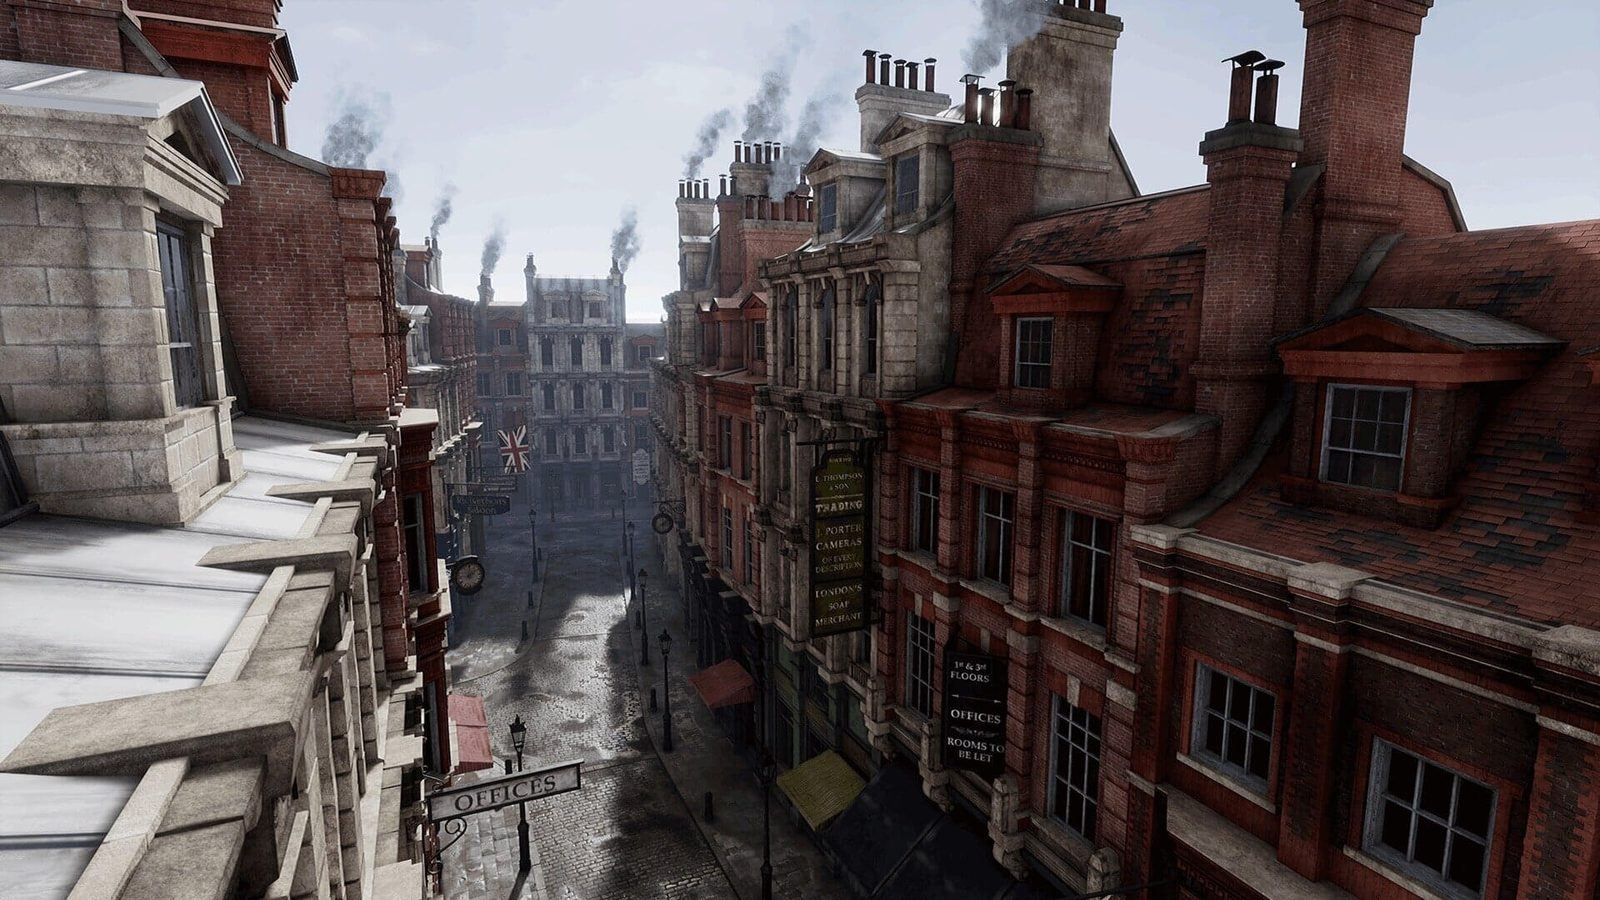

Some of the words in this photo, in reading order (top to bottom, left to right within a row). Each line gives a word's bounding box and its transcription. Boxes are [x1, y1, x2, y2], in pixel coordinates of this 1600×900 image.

[815, 500, 863, 513] TRADING
[825, 523, 862, 536] PORTER
[815, 537, 862, 551] CAMERAS
[815, 583, 863, 598] LONDON'S
[829, 600, 850, 611] SOAP
[815, 612, 862, 628] MERCHANT
[965, 662, 974, 671] &
[950, 670, 990, 683] FLOORS
[950, 709, 1001, 725] OFFICES
[947, 737, 988, 751] ROOMS
[989, 743, 1005, 753] TO
[959, 750, 972, 759] BE
[974, 752, 993, 763] LET
[454, 774, 556, 812] OFFICES
